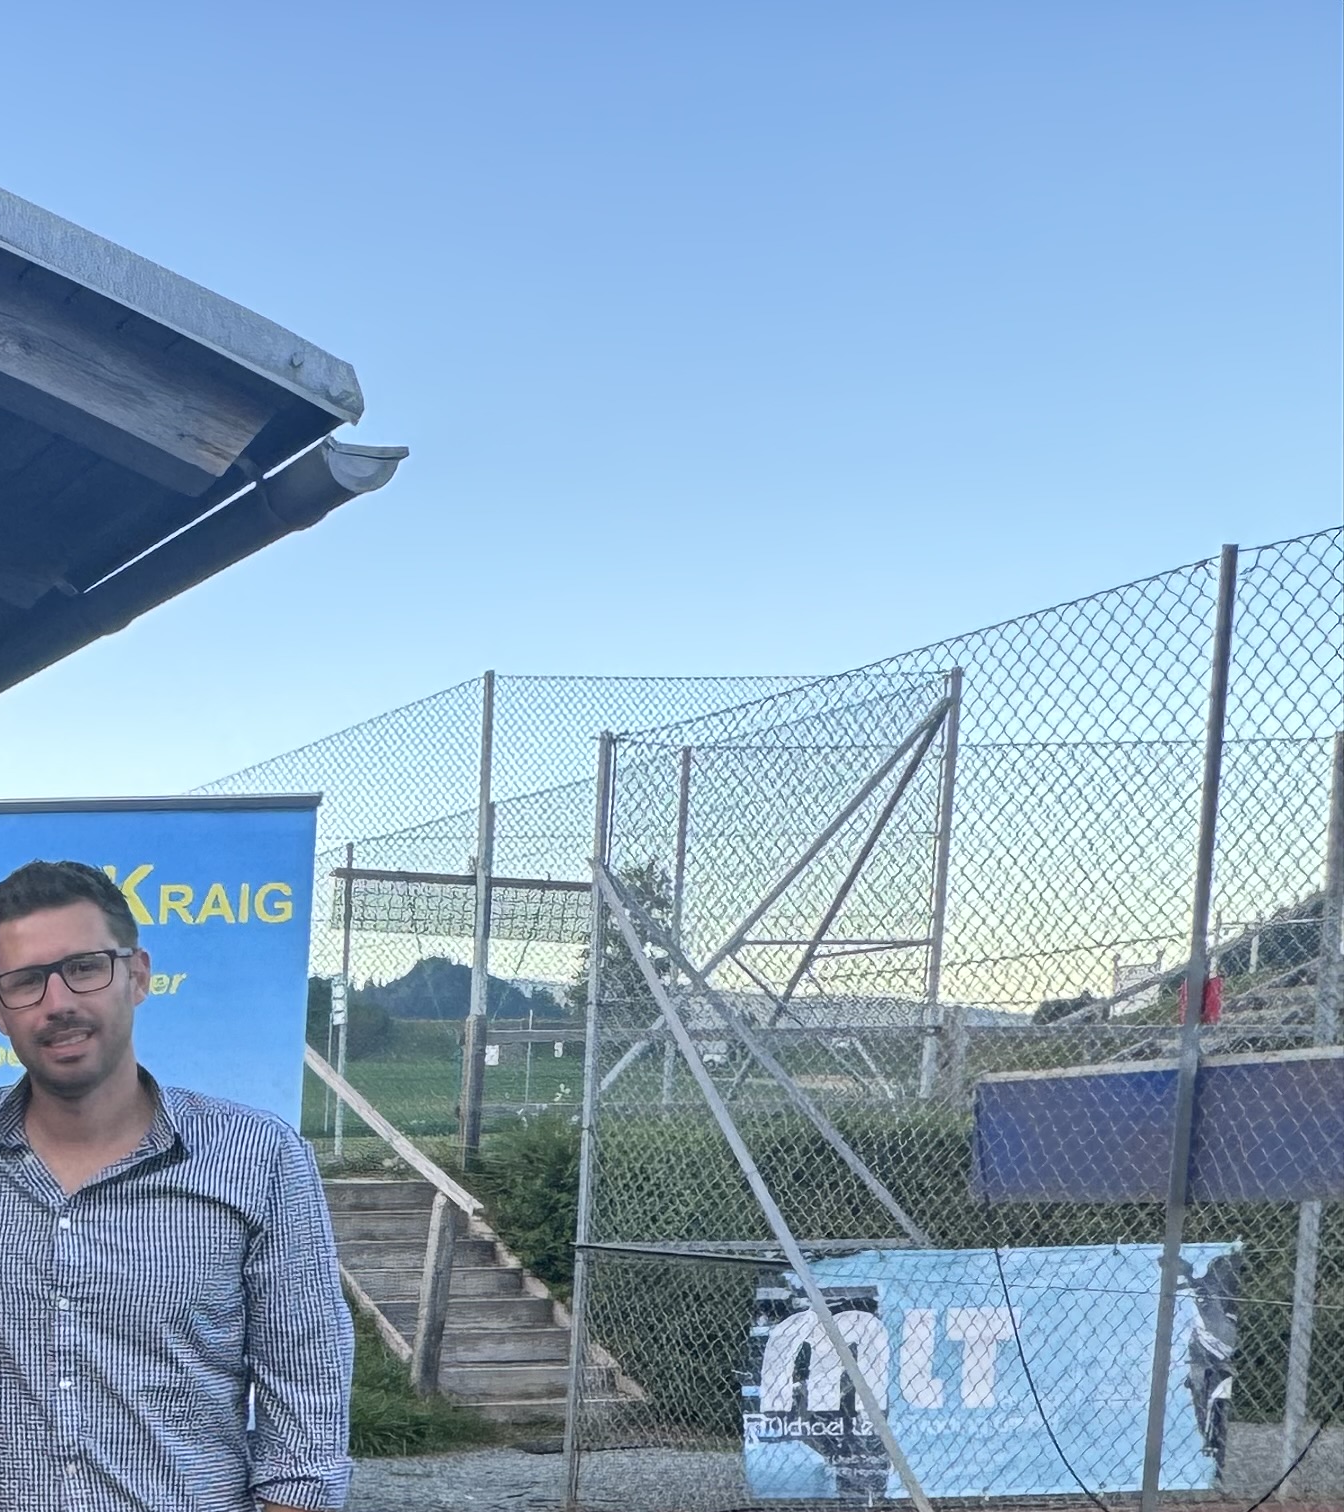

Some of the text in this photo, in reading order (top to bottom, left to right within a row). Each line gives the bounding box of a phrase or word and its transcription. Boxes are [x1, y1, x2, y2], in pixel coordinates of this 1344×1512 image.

[103, 864, 294, 925] KRAIG
[150, 973, 188, 995] er
[760, 1305, 1022, 1412] MLT
